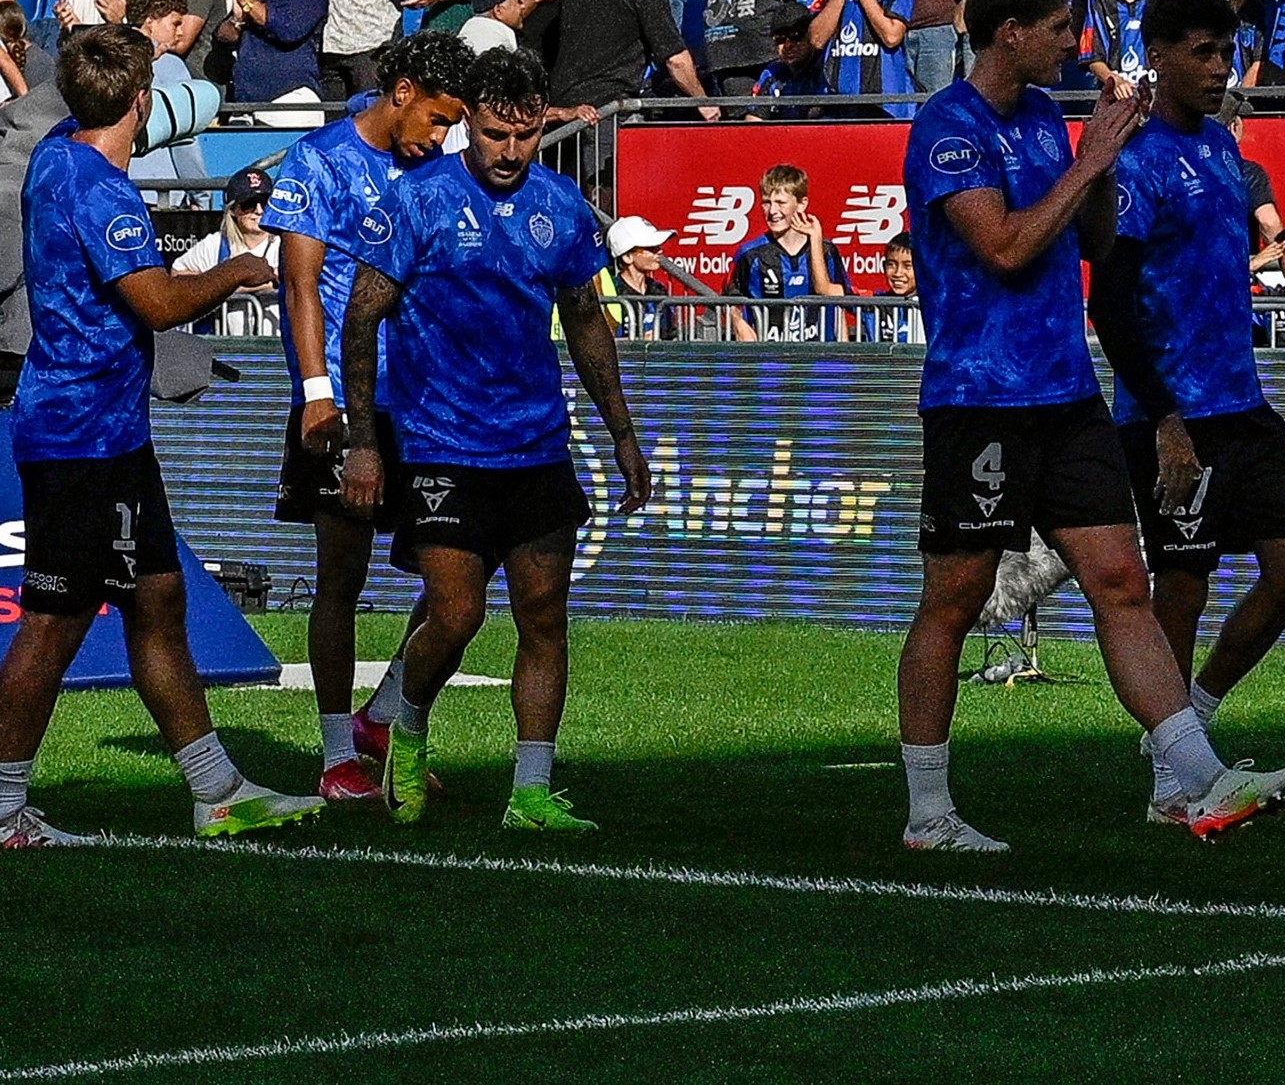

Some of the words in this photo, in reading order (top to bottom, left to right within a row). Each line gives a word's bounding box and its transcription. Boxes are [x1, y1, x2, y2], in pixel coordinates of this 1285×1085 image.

[938, 148, 972, 165] BRUT
[272, 188, 303, 205] BRUT
[363, 216, 386, 234] BRUT
[113, 227, 143, 242] BRUT
[972, 443, 1004, 489] 4
[630, 440, 892, 543] Anchor
[958, 518, 1015, 529] CUPRA
[1163, 540, 1214, 551] CUPRA
